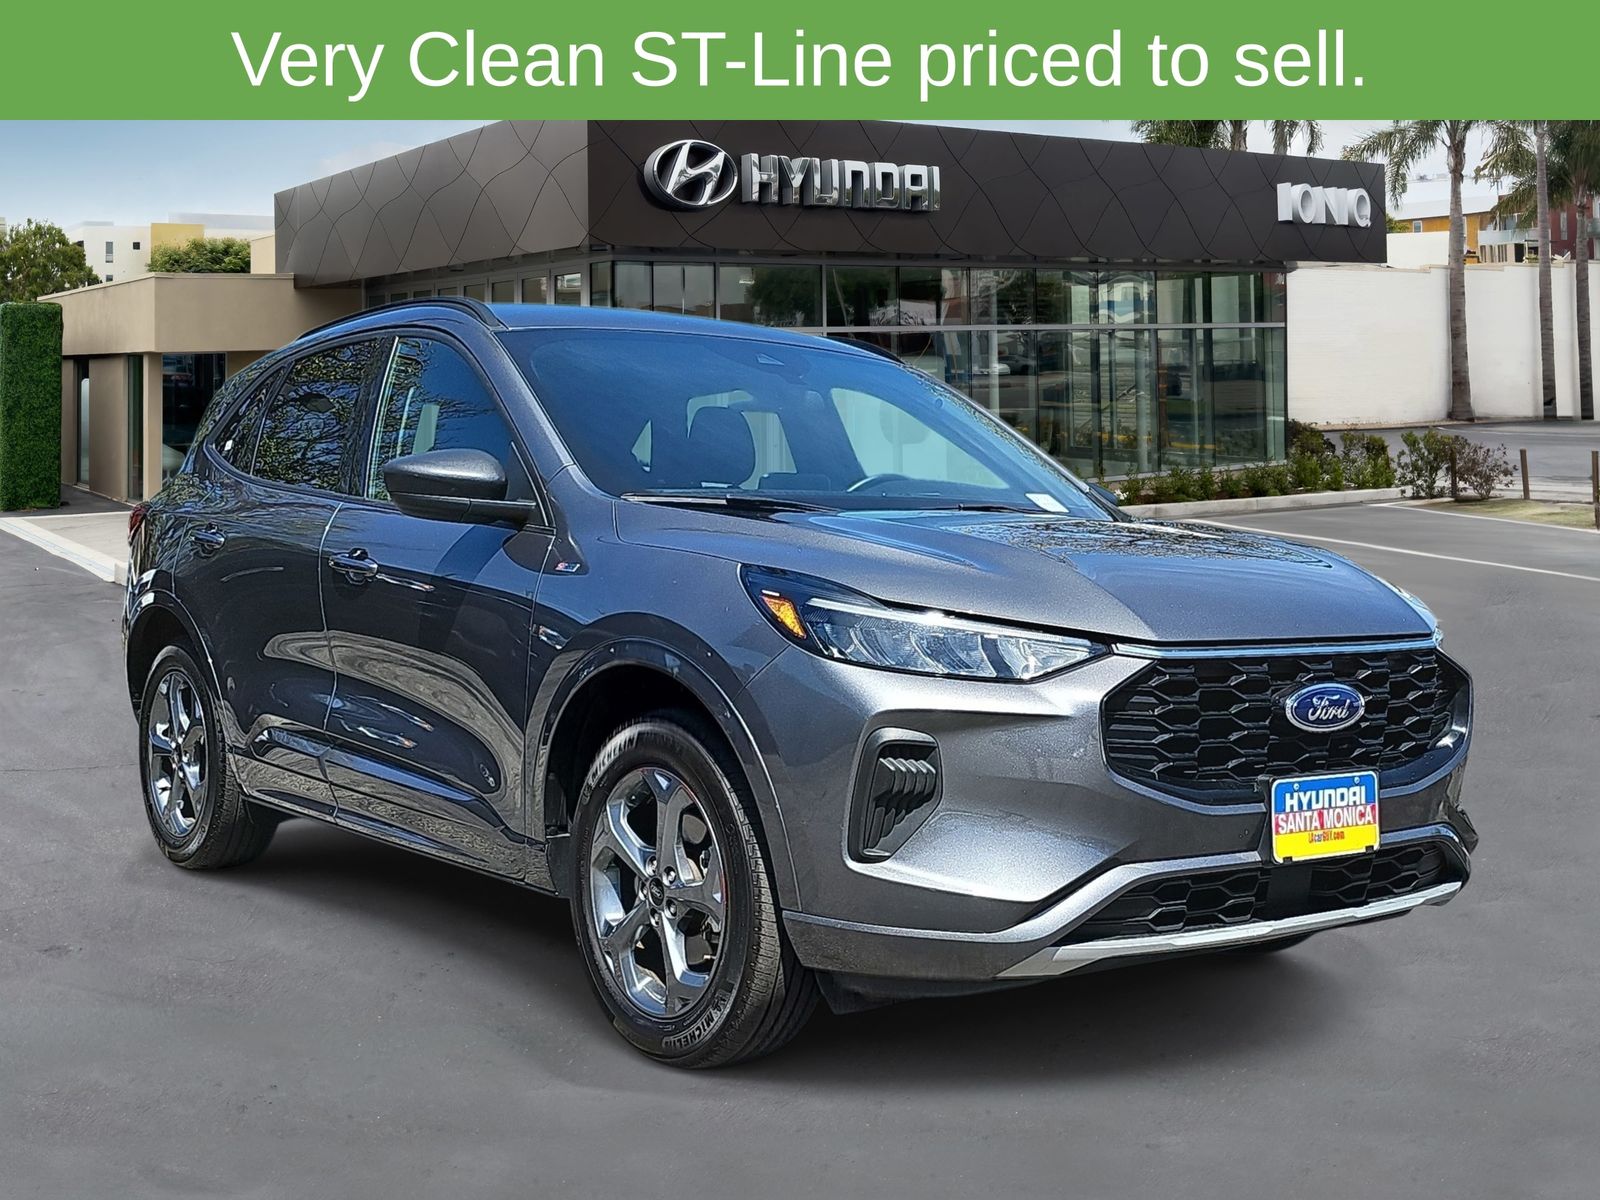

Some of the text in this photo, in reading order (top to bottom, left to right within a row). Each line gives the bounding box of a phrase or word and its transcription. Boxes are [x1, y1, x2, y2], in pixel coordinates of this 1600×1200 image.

[741, 153, 940, 211] HYUNDAI
[1277, 182, 1371, 227] IONIQ
[1308, 694, 1349, 720] Ford
[1285, 785, 1366, 812] HYUNDAI
[1279, 804, 1373, 834] SANTA MONICA
